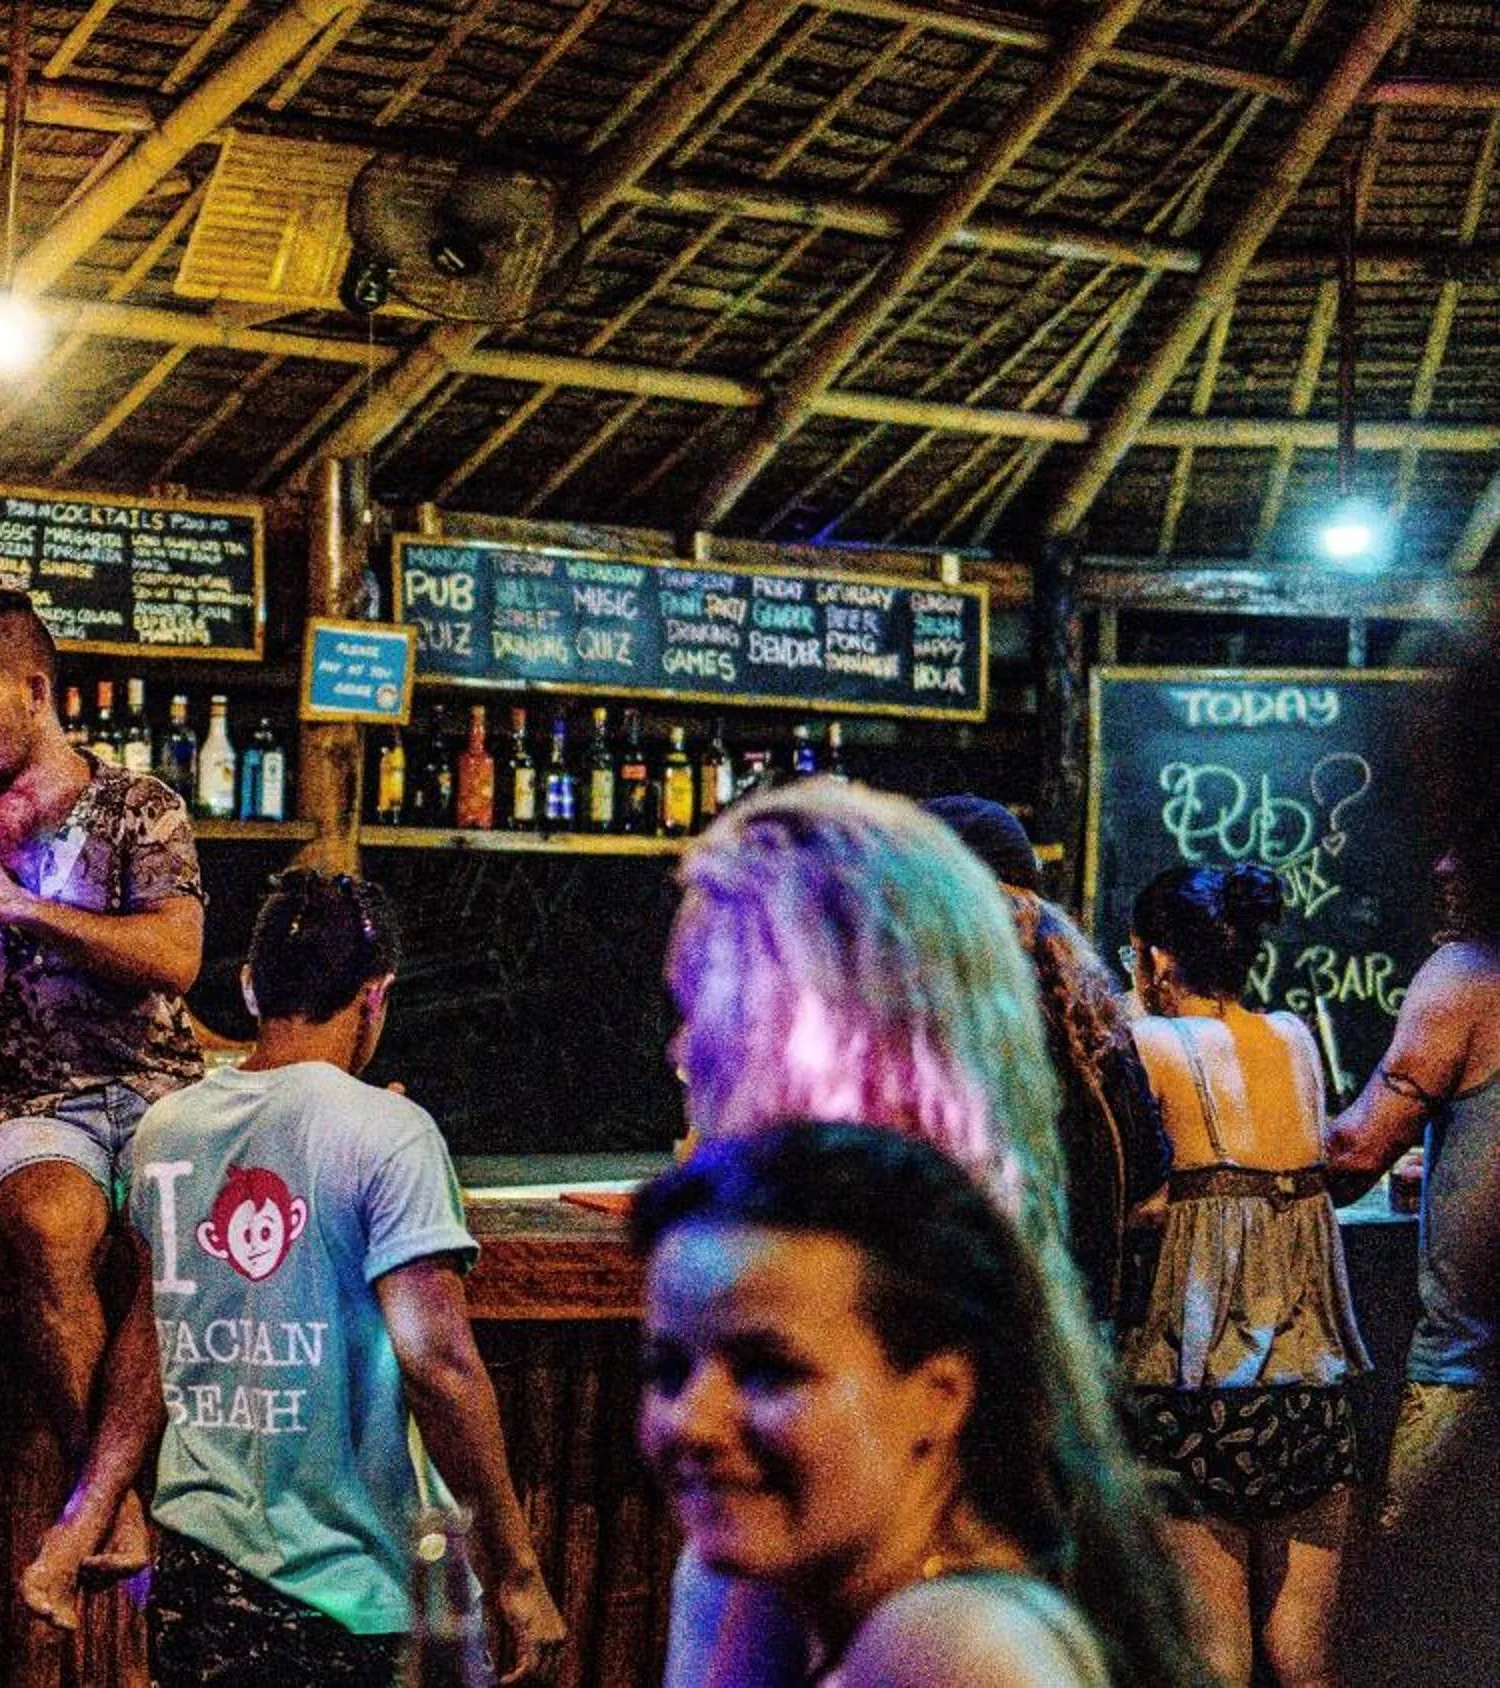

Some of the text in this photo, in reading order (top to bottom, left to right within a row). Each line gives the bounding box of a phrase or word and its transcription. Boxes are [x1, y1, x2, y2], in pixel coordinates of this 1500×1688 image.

[51, 503, 165, 531] COCKTAILS
[404, 569, 475, 612] PUB
[572, 585, 640, 621] MUSIC
[575, 626, 633, 667] QUIZ
[825, 629, 877, 655] PONG
[661, 648, 737, 683] GAMES
[1170, 687, 1341, 728] TODAY
[143, 1160, 198, 1295] I
